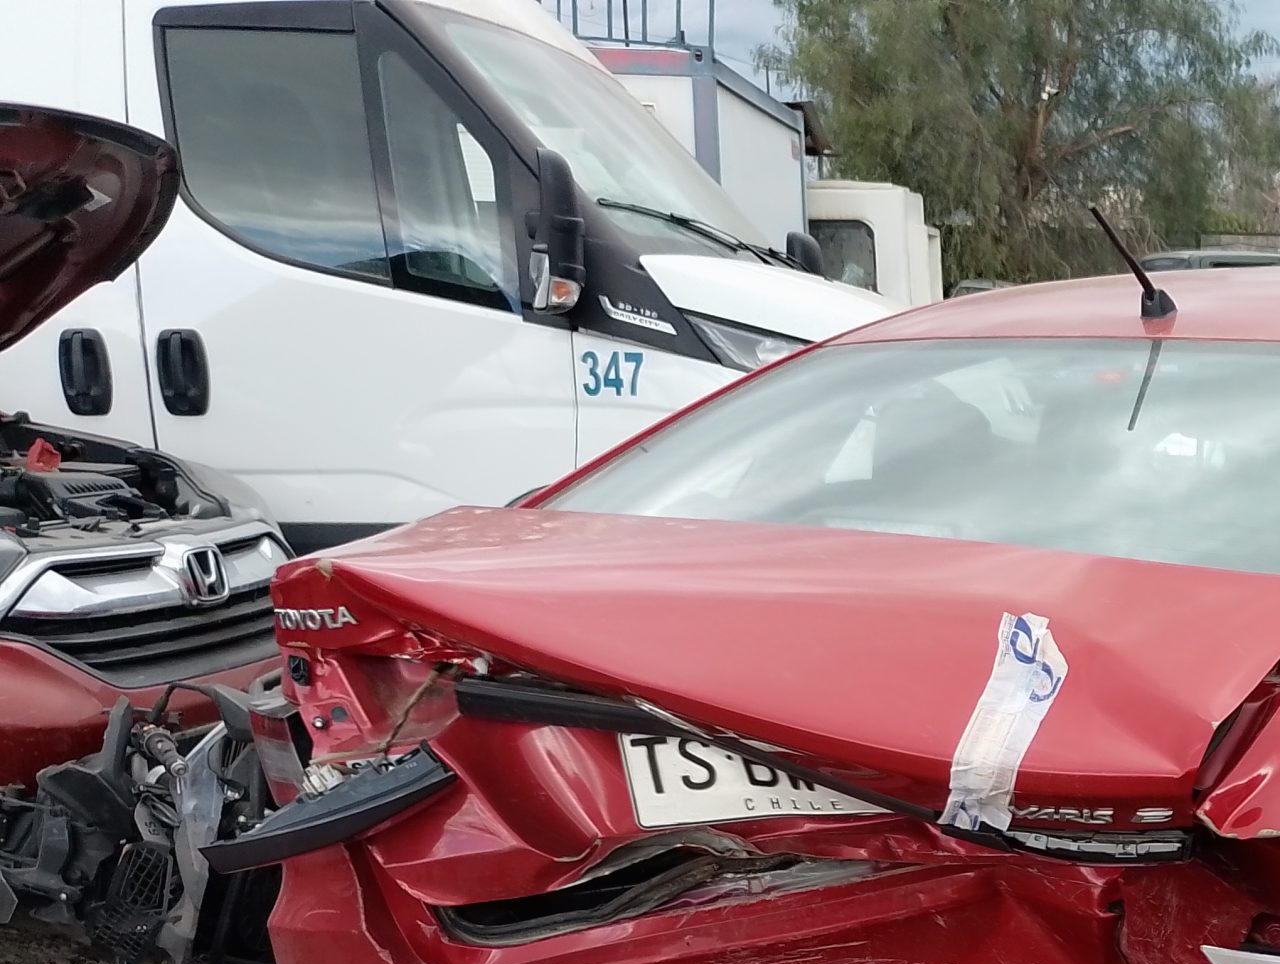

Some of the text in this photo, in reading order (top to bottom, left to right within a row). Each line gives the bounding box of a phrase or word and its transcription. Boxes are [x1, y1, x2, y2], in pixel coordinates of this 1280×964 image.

[613, 311, 661, 327] DAILY CITY
[582, 351, 644, 396] 347
[274, 606, 359, 631] TOYOTA
[744, 797, 844, 811] CHILE
[1008, 804, 1115, 825] YARIS
